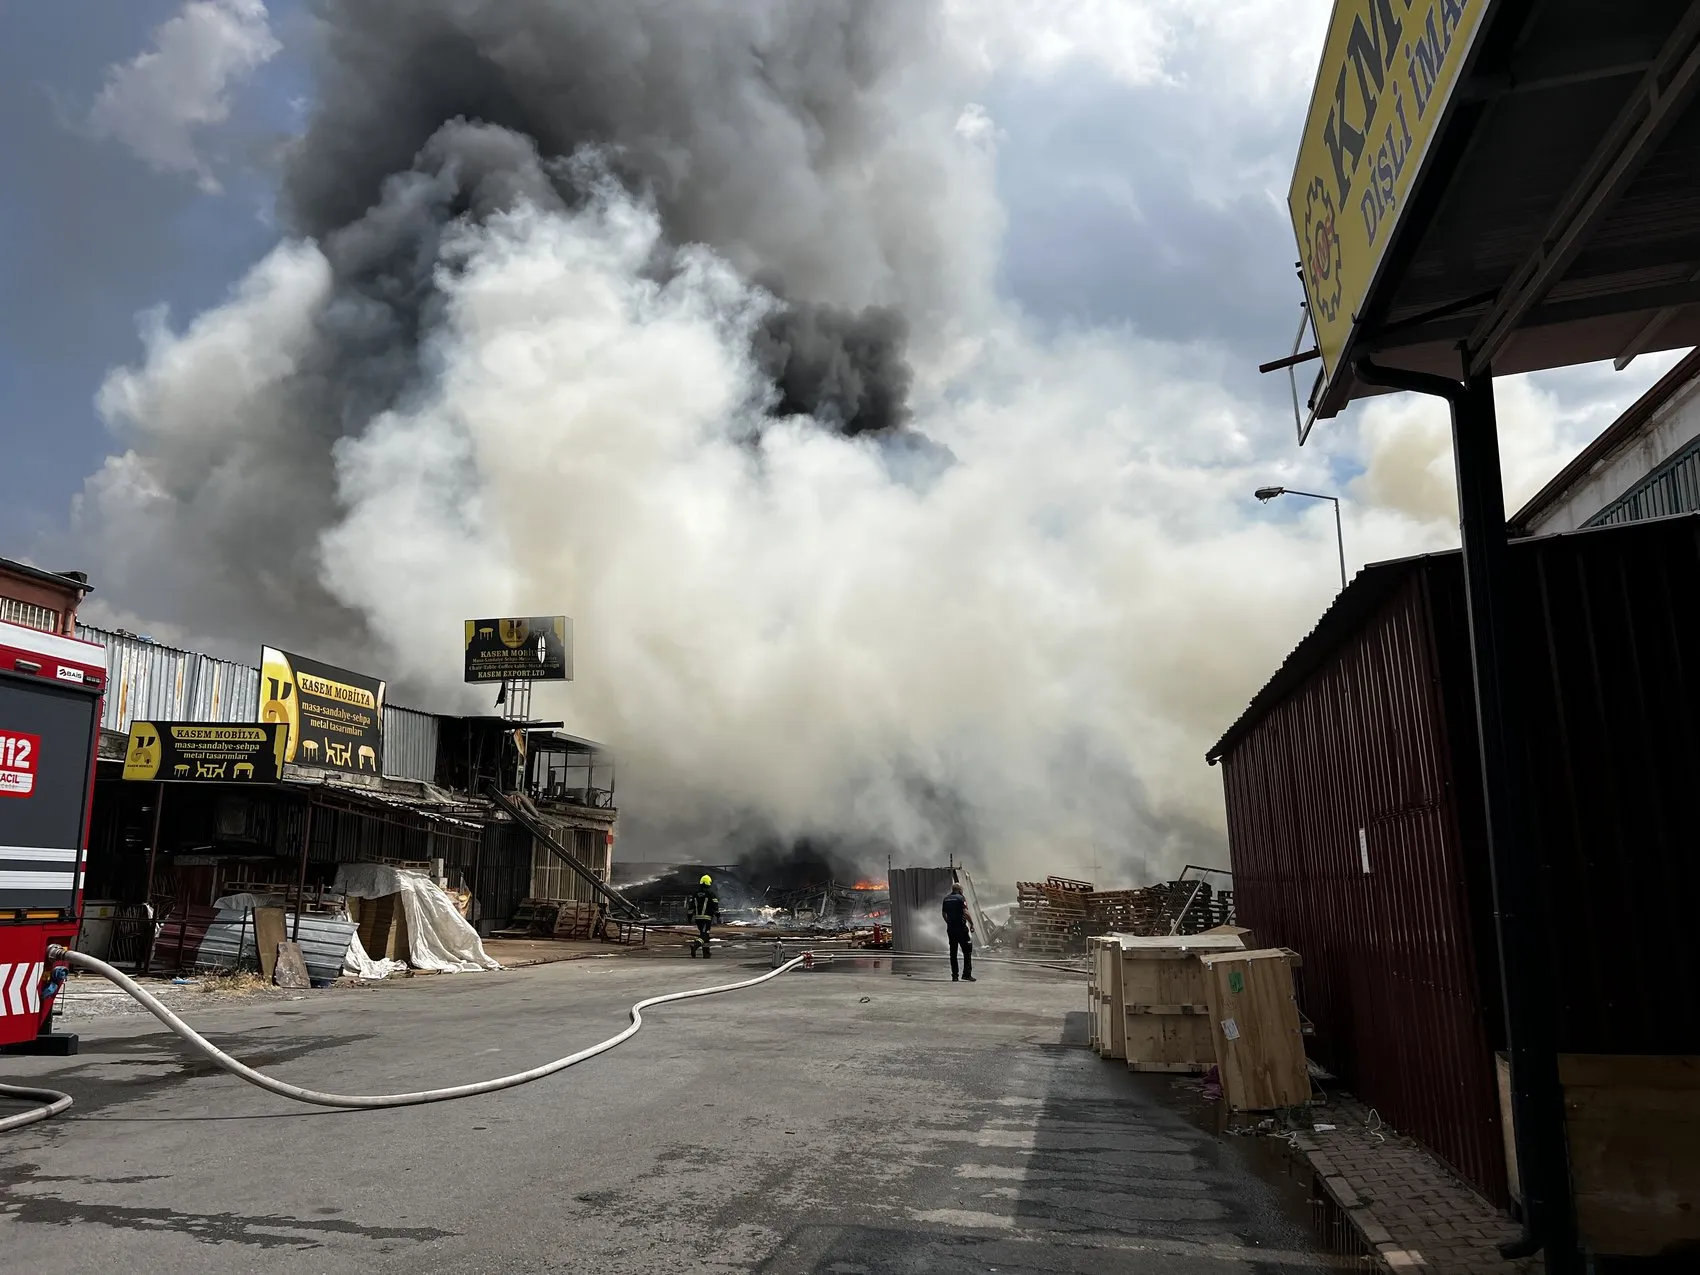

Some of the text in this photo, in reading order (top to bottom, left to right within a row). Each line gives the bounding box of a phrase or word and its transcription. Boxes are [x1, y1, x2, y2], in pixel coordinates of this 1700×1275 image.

[1324, 0, 1413, 214] KM
[1361, 0, 1468, 248] DİŞLİ İMA
[481, 649, 509, 658] KASEM
[301, 678, 371, 706] KASEM MOBİLYA
[301, 701, 371, 725] masa-sandalye-sehpa
[176, 728, 261, 739] KASEM MOBİLYA
[310, 719, 363, 737] metal tasarımları
[174, 742, 260, 752] masa-sandalye-sehpa
[206, 752, 248, 760] tasarımları
